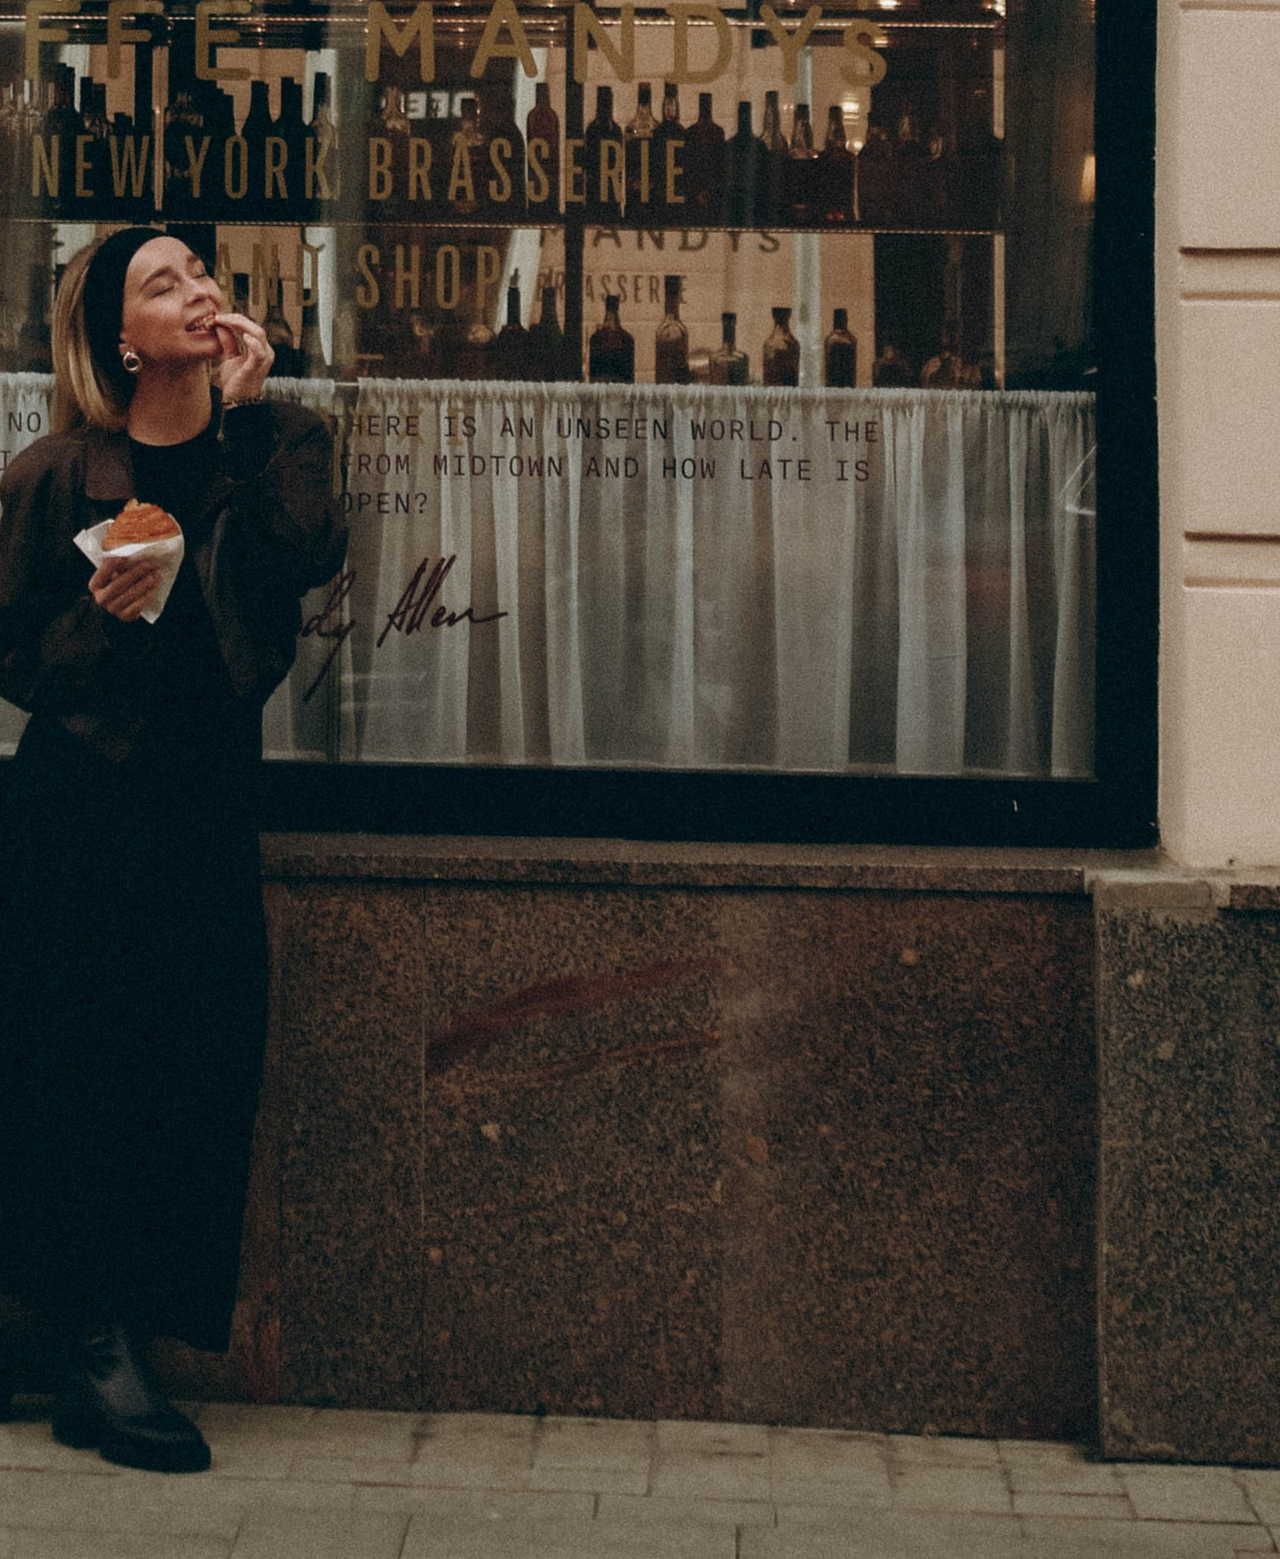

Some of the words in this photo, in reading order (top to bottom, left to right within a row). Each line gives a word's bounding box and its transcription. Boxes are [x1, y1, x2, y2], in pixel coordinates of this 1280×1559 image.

[31, 135, 152, 199] NEW
[185, 136, 335, 200] YORK
[368, 137, 686, 205] BRASSERIE
[214, 243, 319, 308] AND
[357, 243, 502, 310] SHOP
[8, 411, 43, 433] NO
[328, 414, 420, 438] THERE
[444, 415, 477, 439] IS
[500, 417, 535, 440] AN
[556, 417, 669, 441] UNSEEN
[690, 419, 798, 443] WORLD.
[825, 420, 879, 444] THE
[432, 454, 564, 478] MIDTOWN
[586, 456, 640, 479] AND
[662, 457, 717, 481] HOW
[740, 458, 813, 482] LATE
[836, 460, 871, 483] IS
